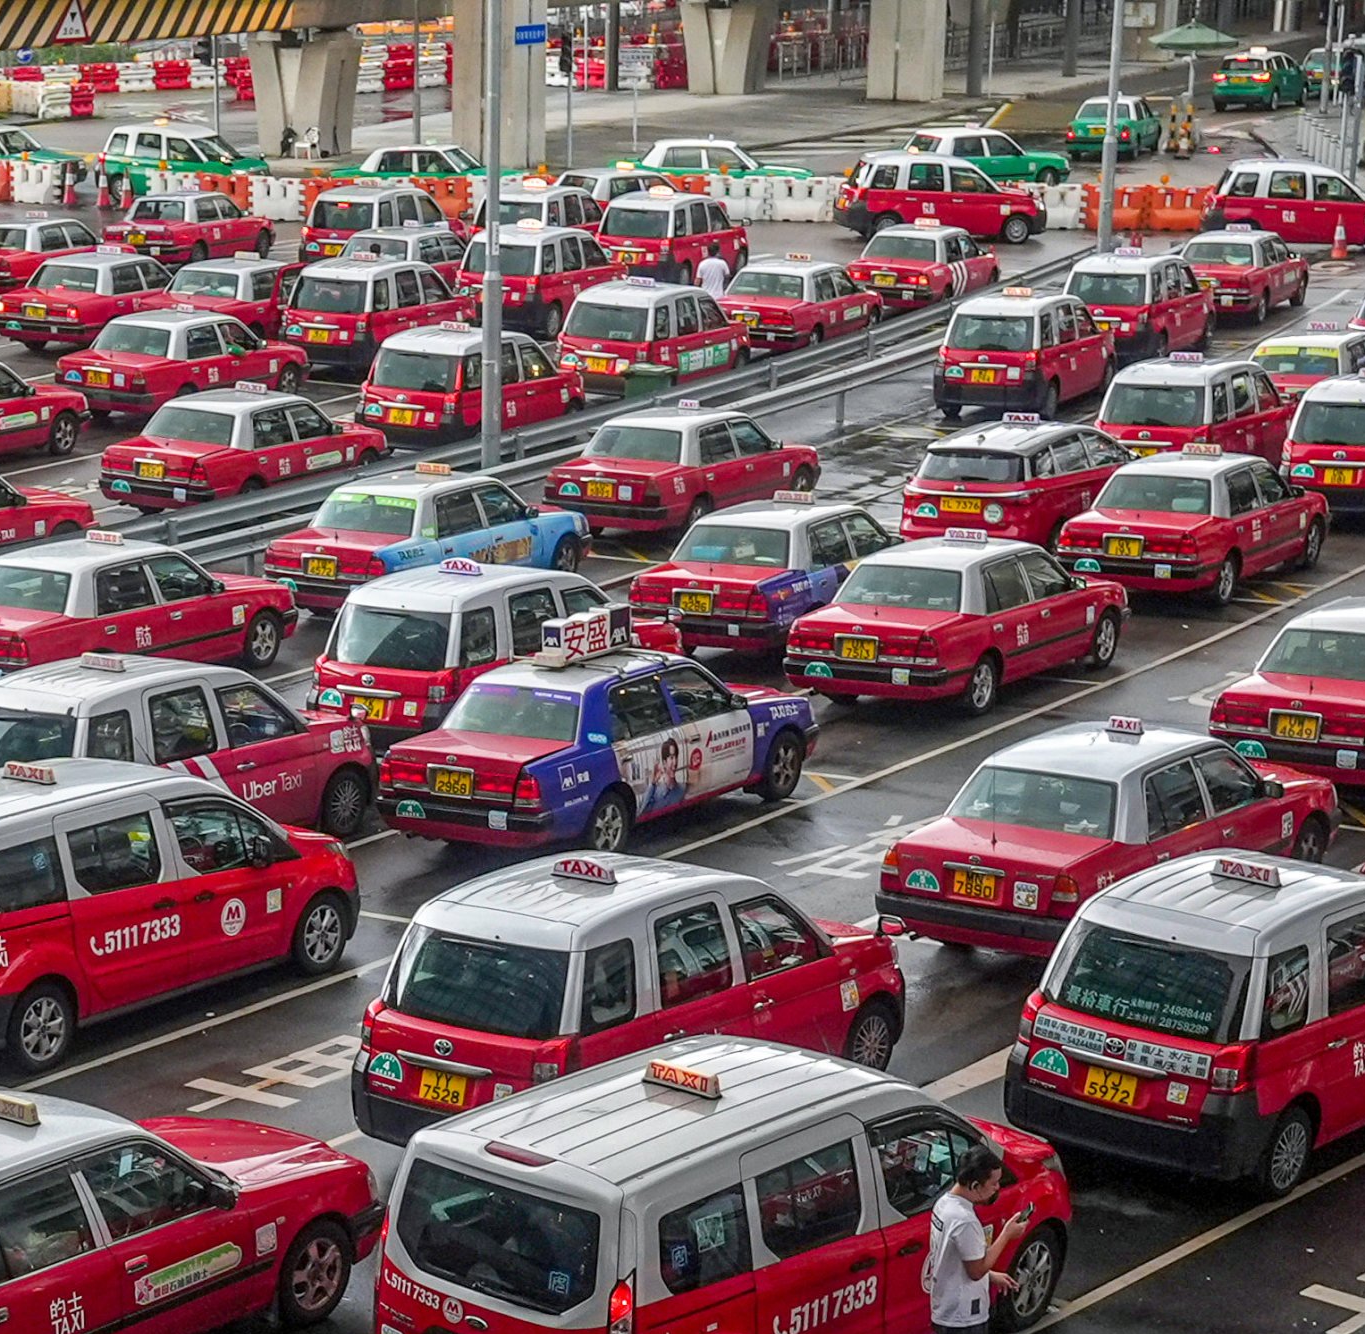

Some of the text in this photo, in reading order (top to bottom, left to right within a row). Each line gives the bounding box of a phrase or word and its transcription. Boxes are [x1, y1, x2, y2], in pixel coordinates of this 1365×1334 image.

[238, 383, 264, 392] TAXI
[1007, 414, 1035, 422] TAXI
[1186, 445, 1219, 454] TAXI
[941, 499, 981, 511] TL 7376
[444, 560, 472, 571] TAXI
[564, 612, 609, 660] 安盛
[1110, 719, 1137, 730] TAXI
[7, 764, 43, 780] TAXI
[242, 770, 303, 802] Uber Taxi
[437, 780, 467, 794] 2968
[561, 861, 604, 878] TAXI
[1219, 860, 1271, 882] TAXI
[955, 880, 993, 898] 7890
[103, 915, 181, 955] 5111 7333
[382, 1059, 390, 1069] 4
[432, 1071, 451, 1085] YY
[651, 1063, 708, 1090] TAXI
[1101, 1069, 1122, 1085] YJ
[421, 1082, 462, 1104] 7528
[1088, 1082, 1132, 1104] 5972
[390, 1270, 441, 1310] 5111 7333
[829, 1276, 878, 1321] 7333
[49, 1292, 83, 1320] 的士
